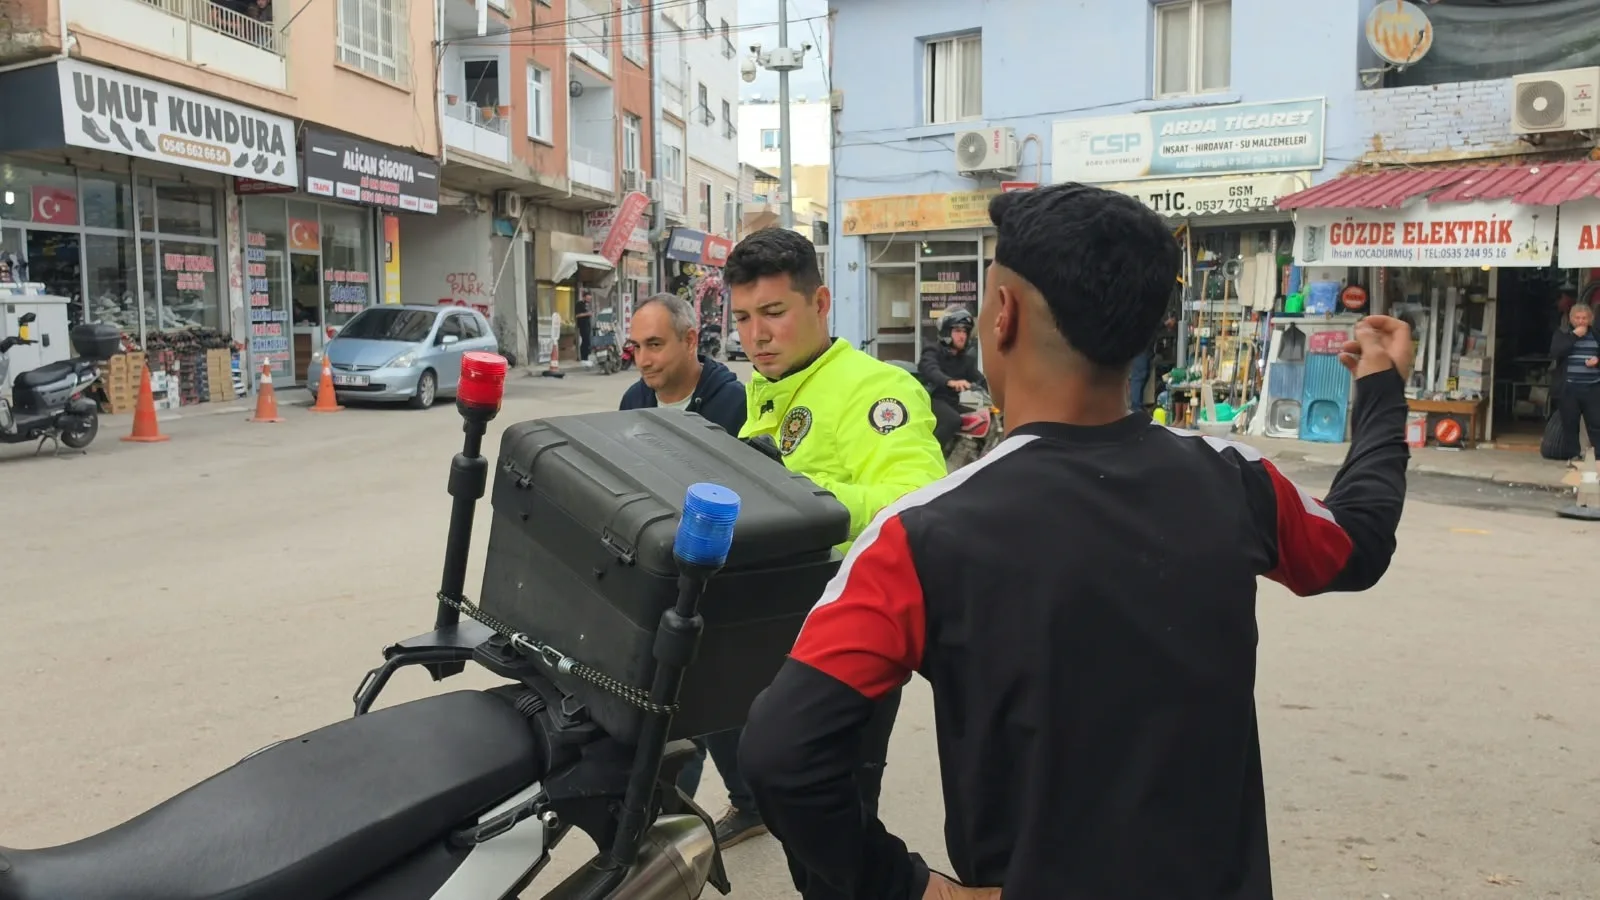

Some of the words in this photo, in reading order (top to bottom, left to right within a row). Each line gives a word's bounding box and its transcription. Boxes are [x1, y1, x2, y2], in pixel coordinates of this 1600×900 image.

[73, 72, 158, 126] UMUT
[168, 96, 286, 156] KUNDURA
[1160, 117, 1217, 137] ARDA
[1224, 110, 1313, 131] TİCARET
[1090, 132, 1141, 155] CSP
[1196, 141, 1233, 153] HIRDAVAT
[1240, 140, 1250, 149] SU
[1252, 134, 1307, 148] MALZEMELERİ
[343, 147, 377, 175] ALİCAN
[378, 154, 414, 183] SİGORTA
[1150, 190, 1192, 211] TİC.
[1195, 199, 1223, 211] 0537
[1229, 198, 1249, 209] 703
[1229, 186, 1253, 196] GSM
[1330, 217, 1396, 246] GÖZDE
[1402, 213, 1513, 245] ELEKTRİK
[1331, 248, 1353, 259] İhsan
[1354, 248, 1413, 261] KOCADURMUŞ
[1424, 247, 1461, 259] TEL:0535
[1464, 247, 1480, 258] 244
[1482, 247, 1493, 258] 95
[446, 272, 477, 286] OTO
[451, 282, 487, 296] PARK
